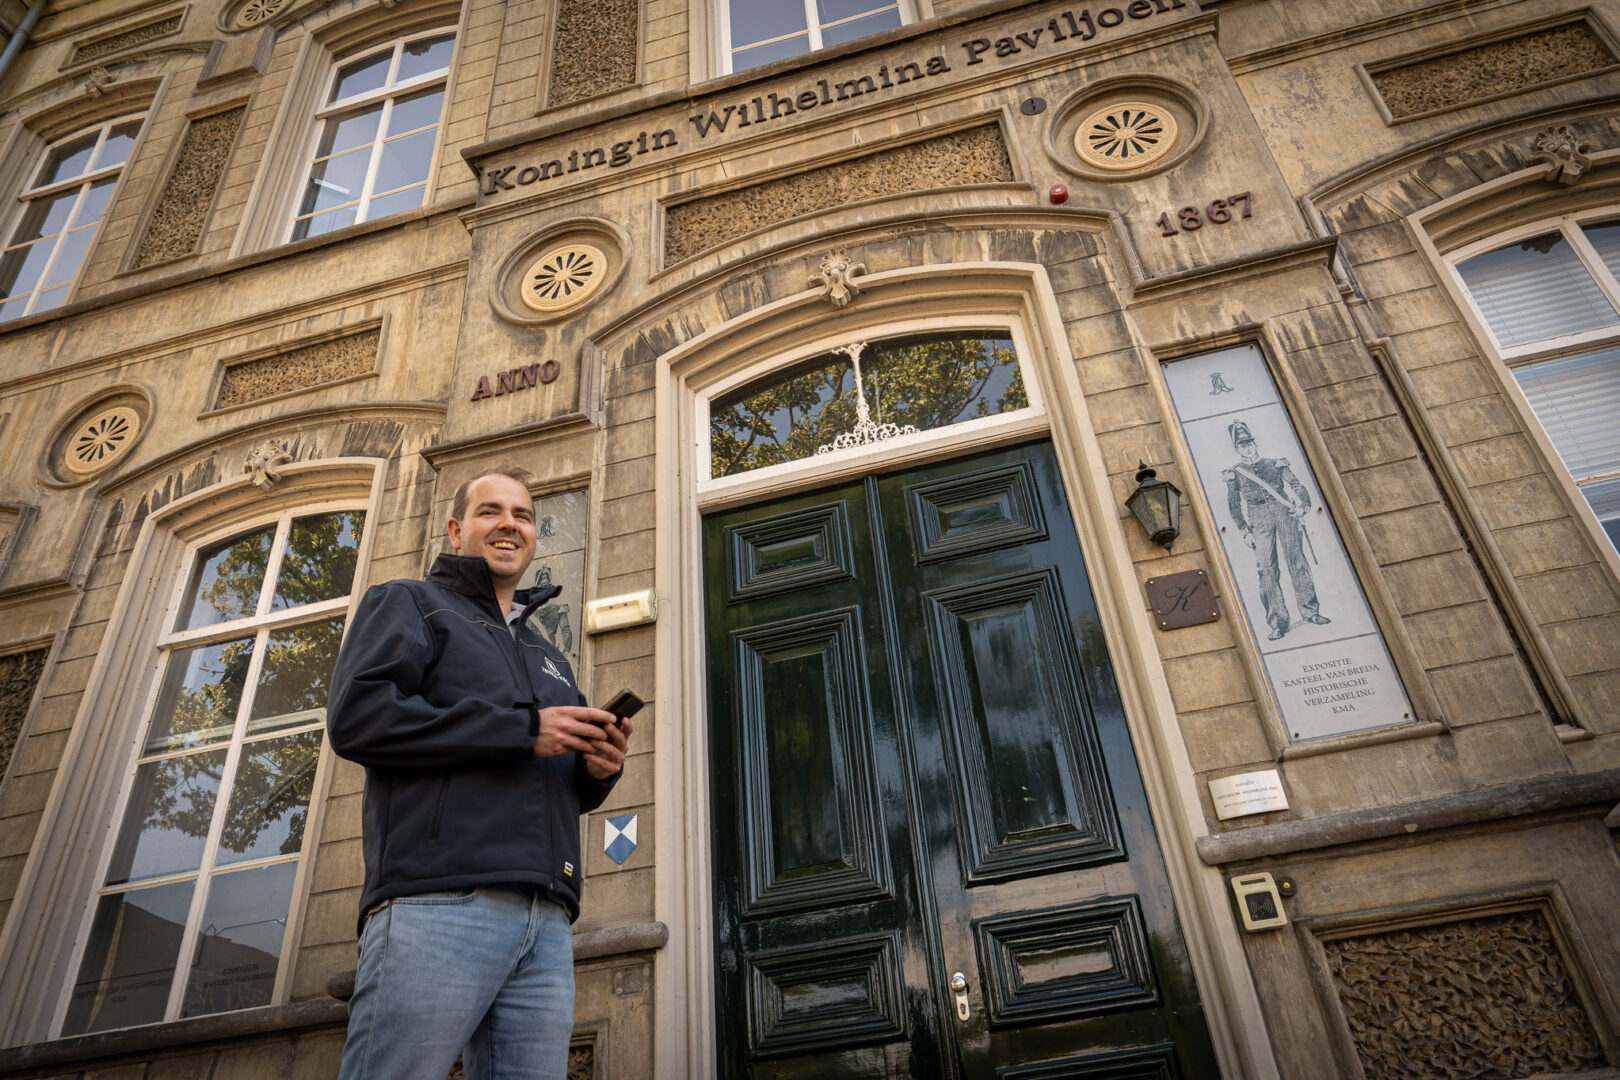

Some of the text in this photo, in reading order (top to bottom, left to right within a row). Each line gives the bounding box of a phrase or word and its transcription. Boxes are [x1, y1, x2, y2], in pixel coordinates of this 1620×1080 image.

[484, 128, 678, 196] Koningin
[689, 55, 951, 138] Wilhelmina
[1156, 191, 1252, 238] 1867
[470, 360, 561, 402] ANNO
[1302, 657, 1353, 673] EXPOSITIE
[1283, 664, 1380, 688] KASTEEL VAN BREDA
[1303, 678, 1368, 695] HISTORISCHE
[1304, 688, 1375, 706] VERZAMELING
[1332, 703, 1356, 714] KMA
